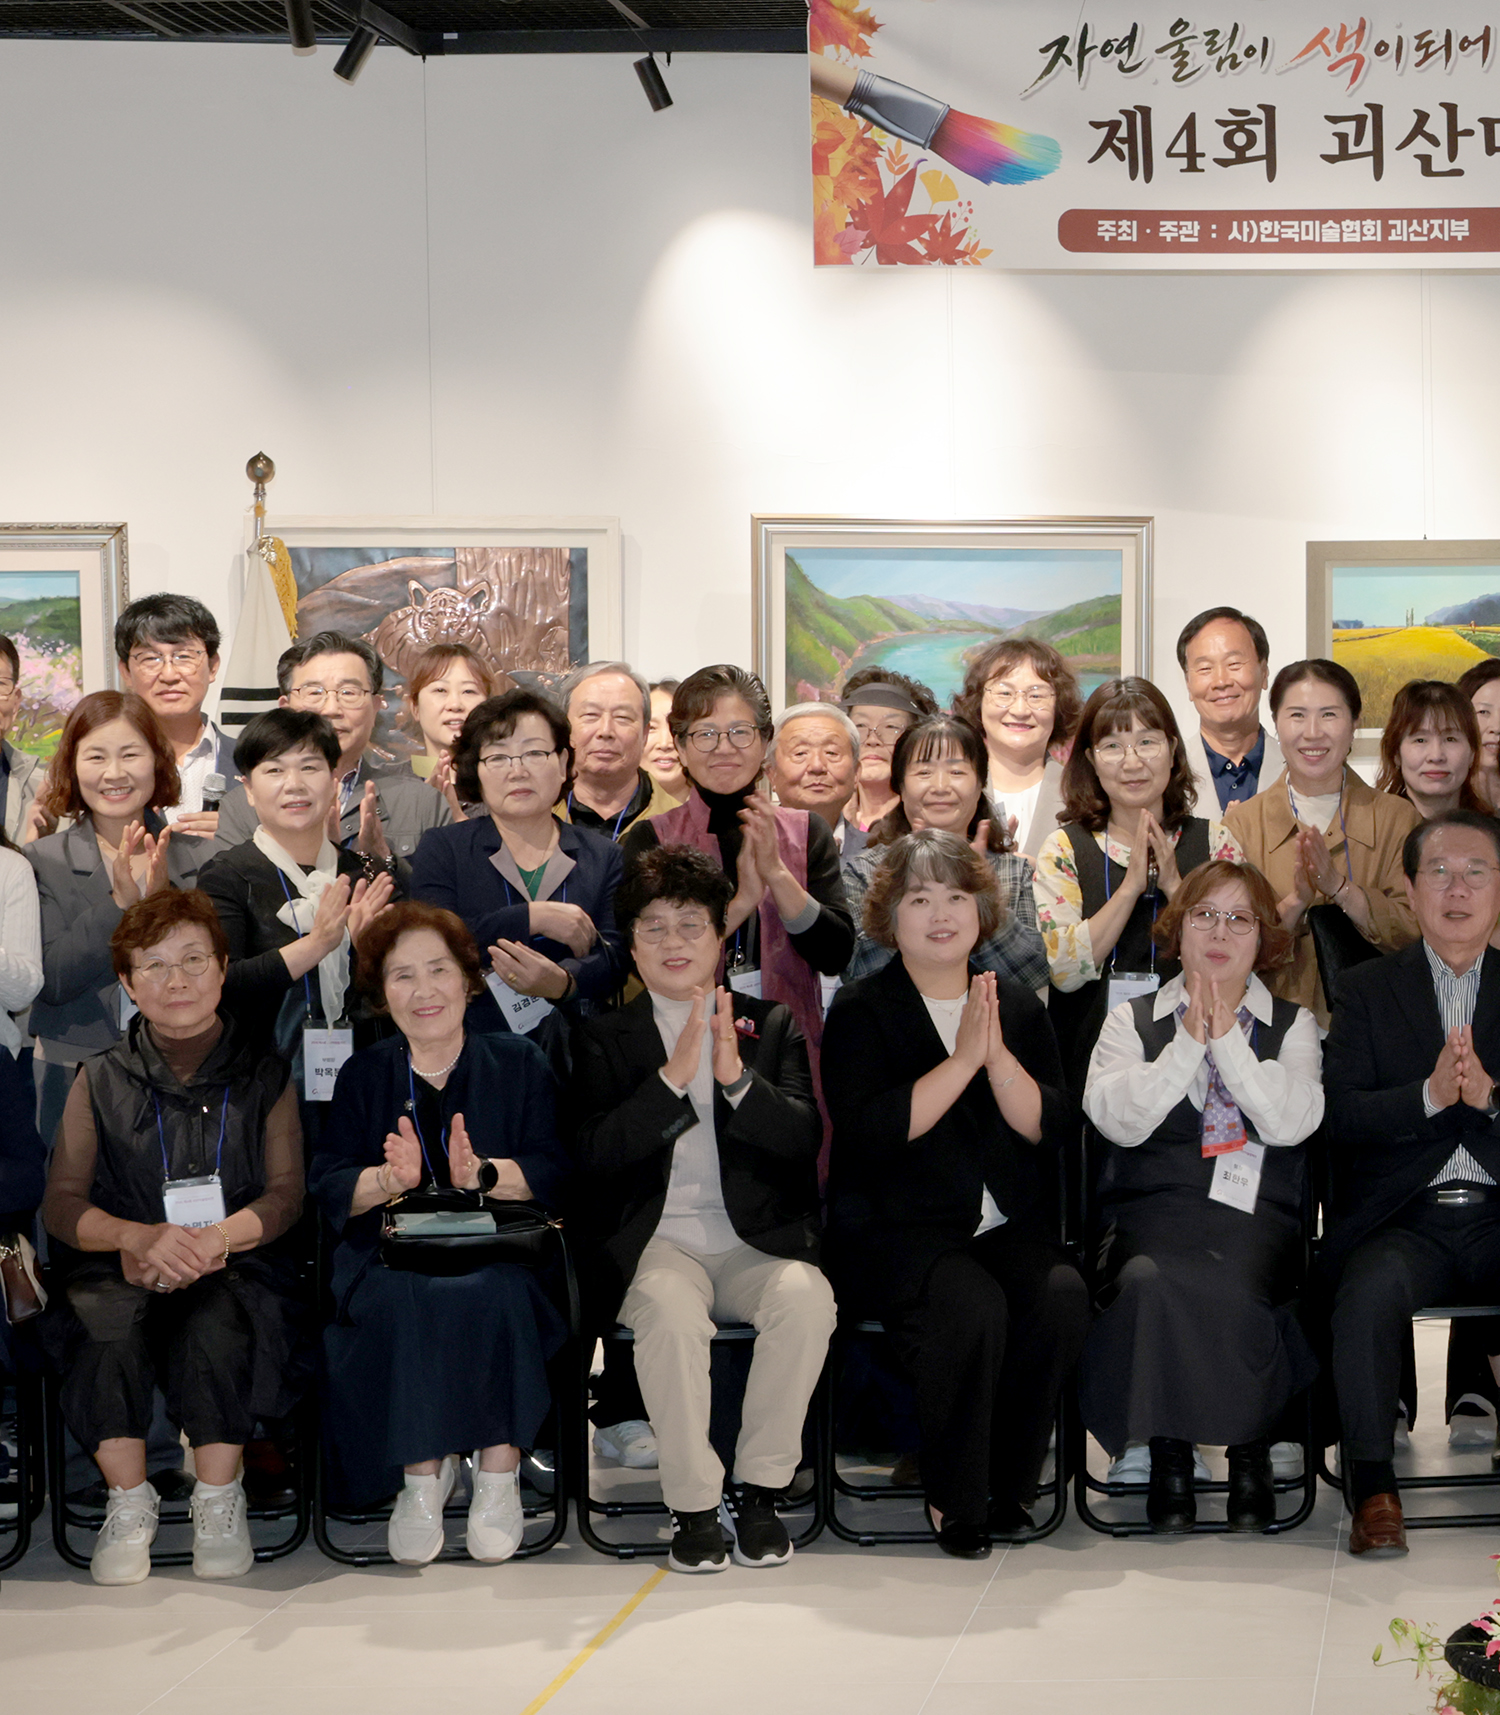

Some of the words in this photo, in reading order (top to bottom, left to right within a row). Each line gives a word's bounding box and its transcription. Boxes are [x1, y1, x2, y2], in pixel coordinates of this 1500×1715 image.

[1087, 104, 1277, 184] 제4회
[1096, 219, 1138, 242] 주최
[1158, 219, 1201, 242] 주관
[1227, 218, 1381, 243] 사)한국미술협회
[1388, 218, 1470, 242] 괴산지부
